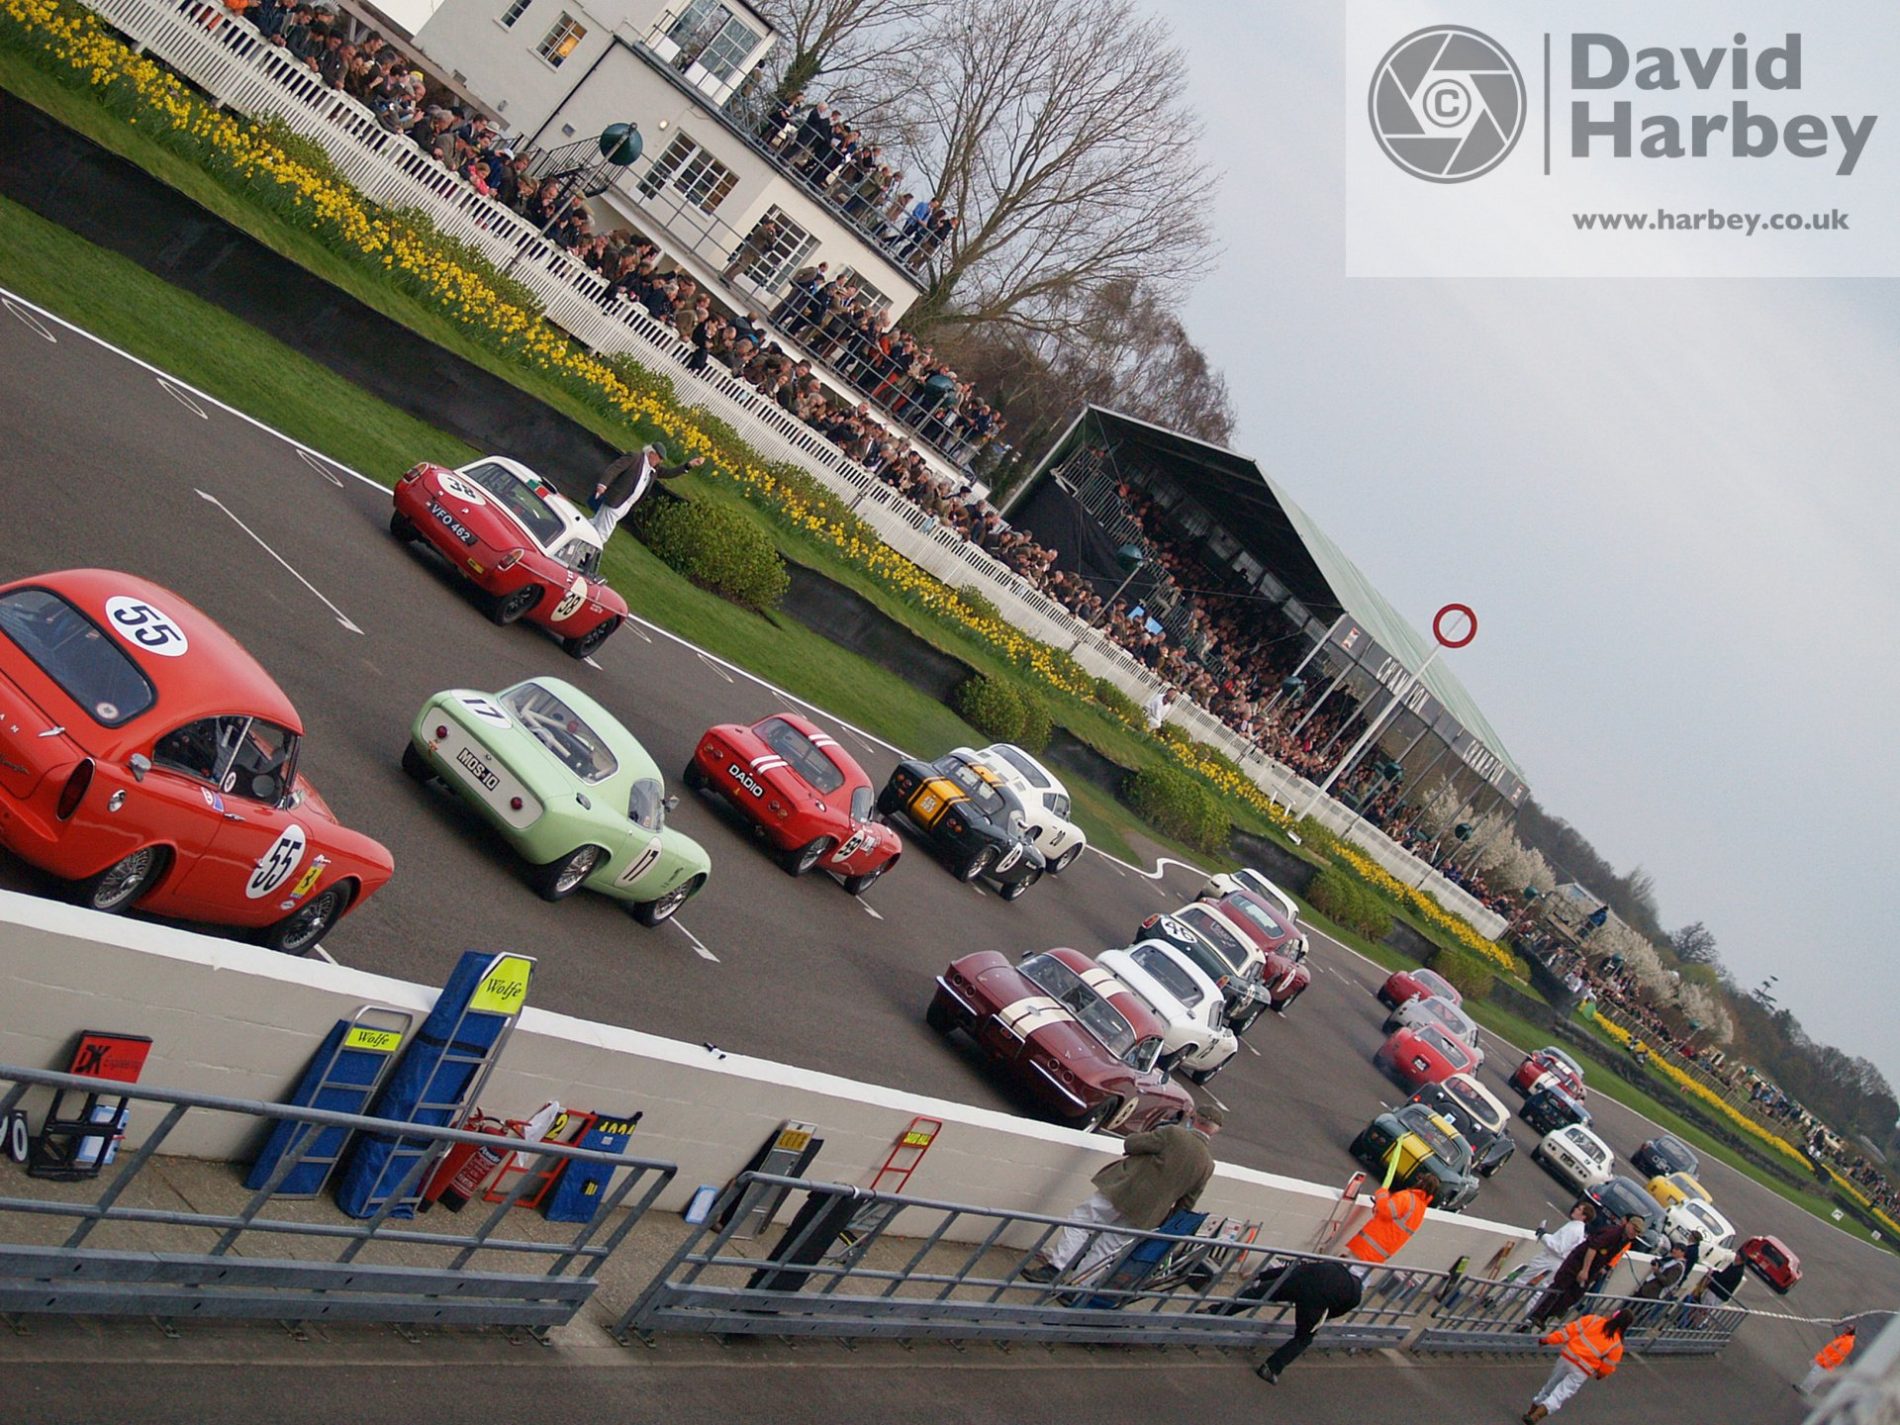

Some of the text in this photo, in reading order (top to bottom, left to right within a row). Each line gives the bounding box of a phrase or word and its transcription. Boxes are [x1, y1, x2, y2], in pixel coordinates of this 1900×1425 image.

[448, 477, 477, 499] 38
[430, 504, 472, 543] VFO 462
[556, 592, 582, 617] 38
[113, 605, 182, 647] 55
[462, 698, 505, 720] 17
[727, 763, 764, 799] DADIO
[251, 837, 303, 892] 55
[622, 848, 660, 882] 17
[484, 977, 523, 1000] Wolfe
[357, 1029, 390, 1047] Wolfe
[545, 1113, 569, 1140] 2
